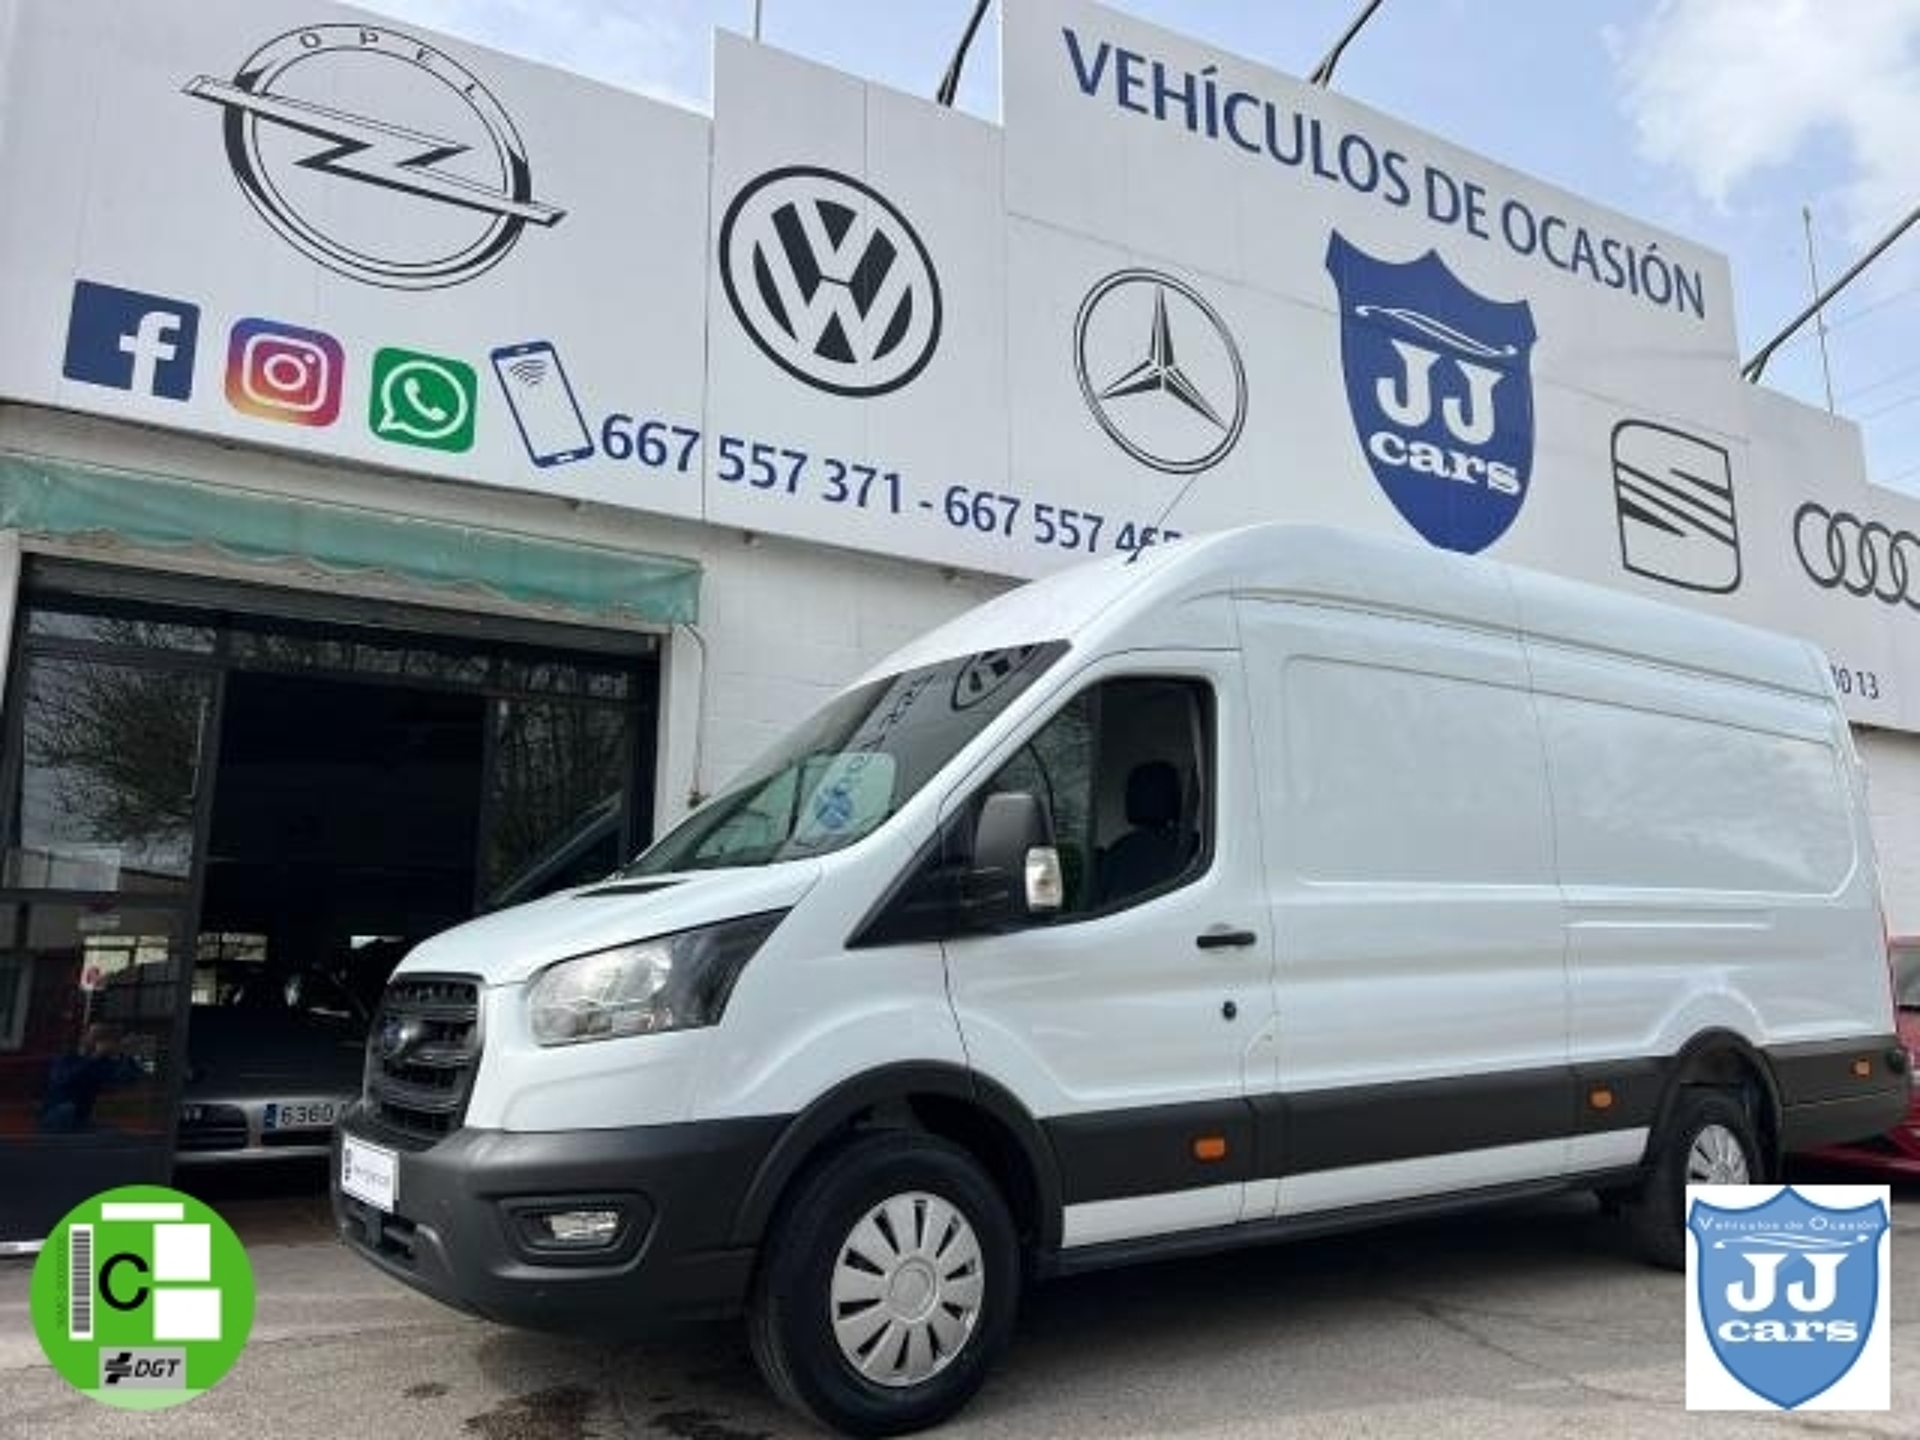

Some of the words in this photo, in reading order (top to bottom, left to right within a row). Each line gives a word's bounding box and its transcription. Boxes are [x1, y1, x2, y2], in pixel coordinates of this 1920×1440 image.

[299, 26, 476, 100] OPEL
[1061, 27, 1411, 208] VEHÍCULOS
[1425, 167, 1490, 241] DE
[1501, 199, 1706, 320] OCASIÓN
[1375, 336, 1507, 446] JJ
[601, 413, 701, 473] 667
[717, 435, 808, 495] 557
[822, 457, 901, 514] 371
[945, 484, 1022, 537] 667
[1033, 503, 1104, 554] 557
[1368, 429, 1522, 498] cars
[1856, 671, 1879, 700] 13
